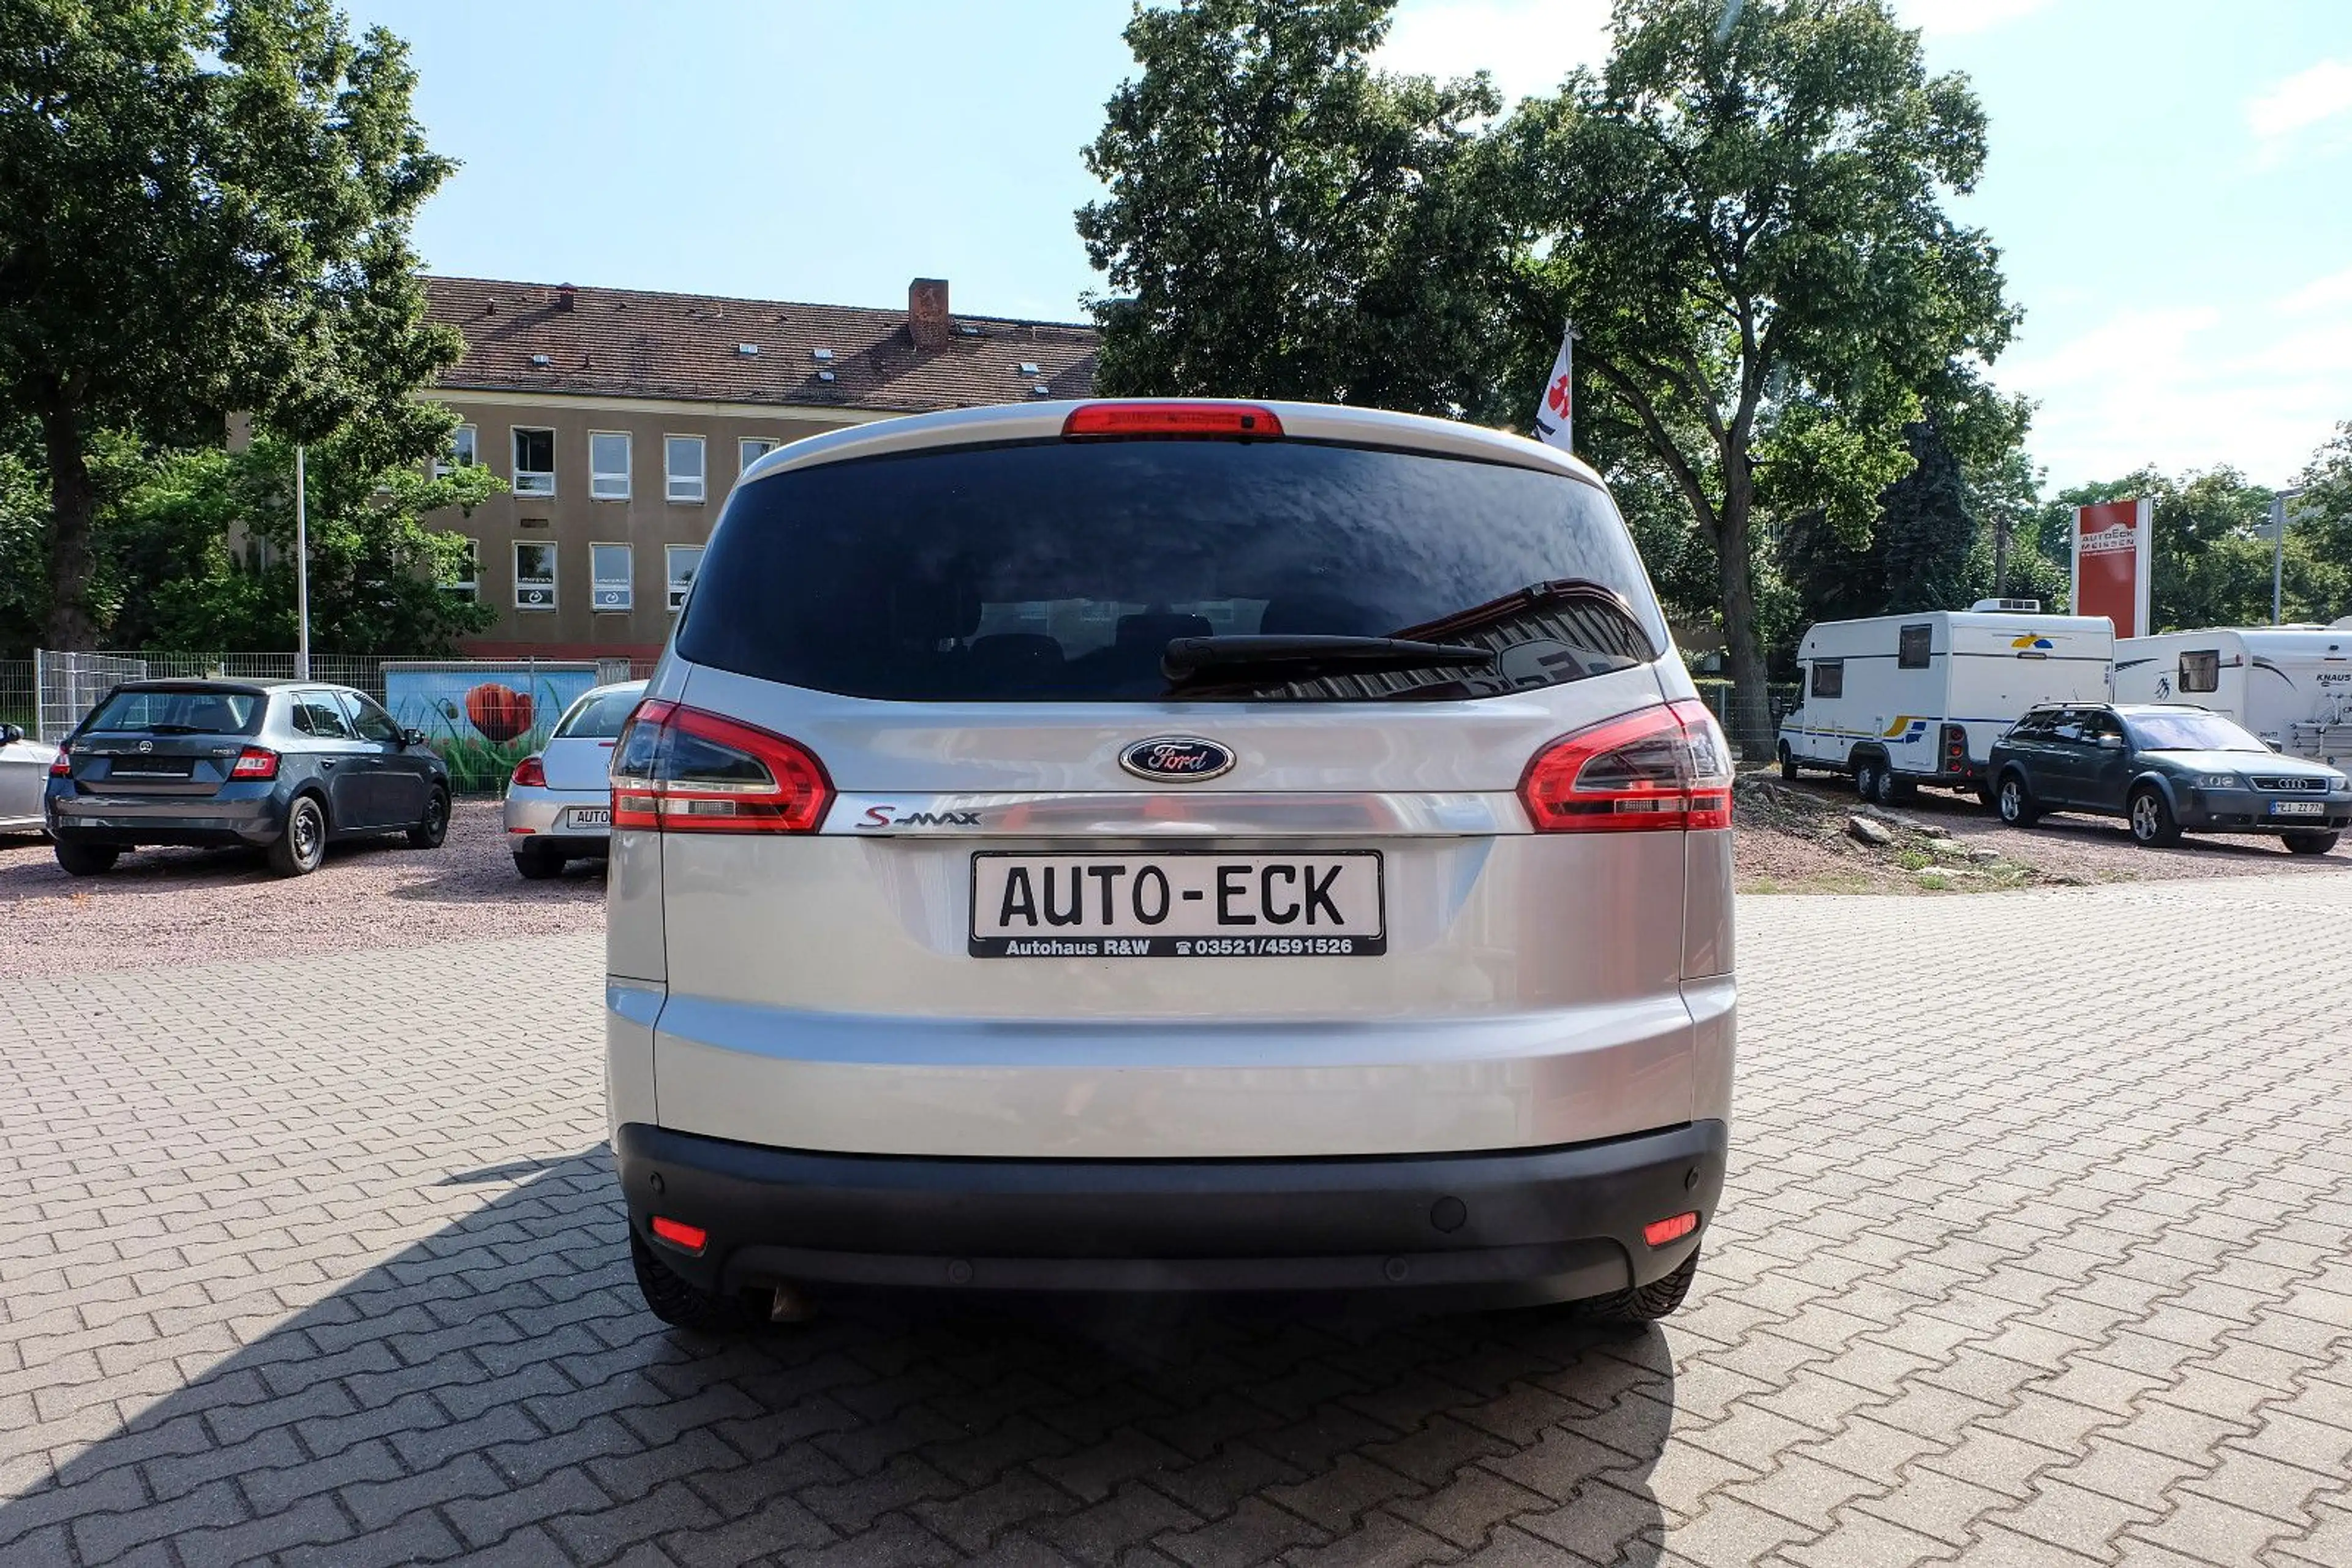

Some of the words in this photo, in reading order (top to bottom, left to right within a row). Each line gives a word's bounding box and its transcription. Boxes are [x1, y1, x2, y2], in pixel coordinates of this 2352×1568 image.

[1148, 744, 1208, 770] Ford
[577, 811, 611, 822] AUTO
[855, 805, 981, 827] S-MAX
[1006, 940, 1098, 956] Autohaus
[1104, 940, 1150, 956] R&W
[1195, 939, 1354, 956] 03521/4591526
